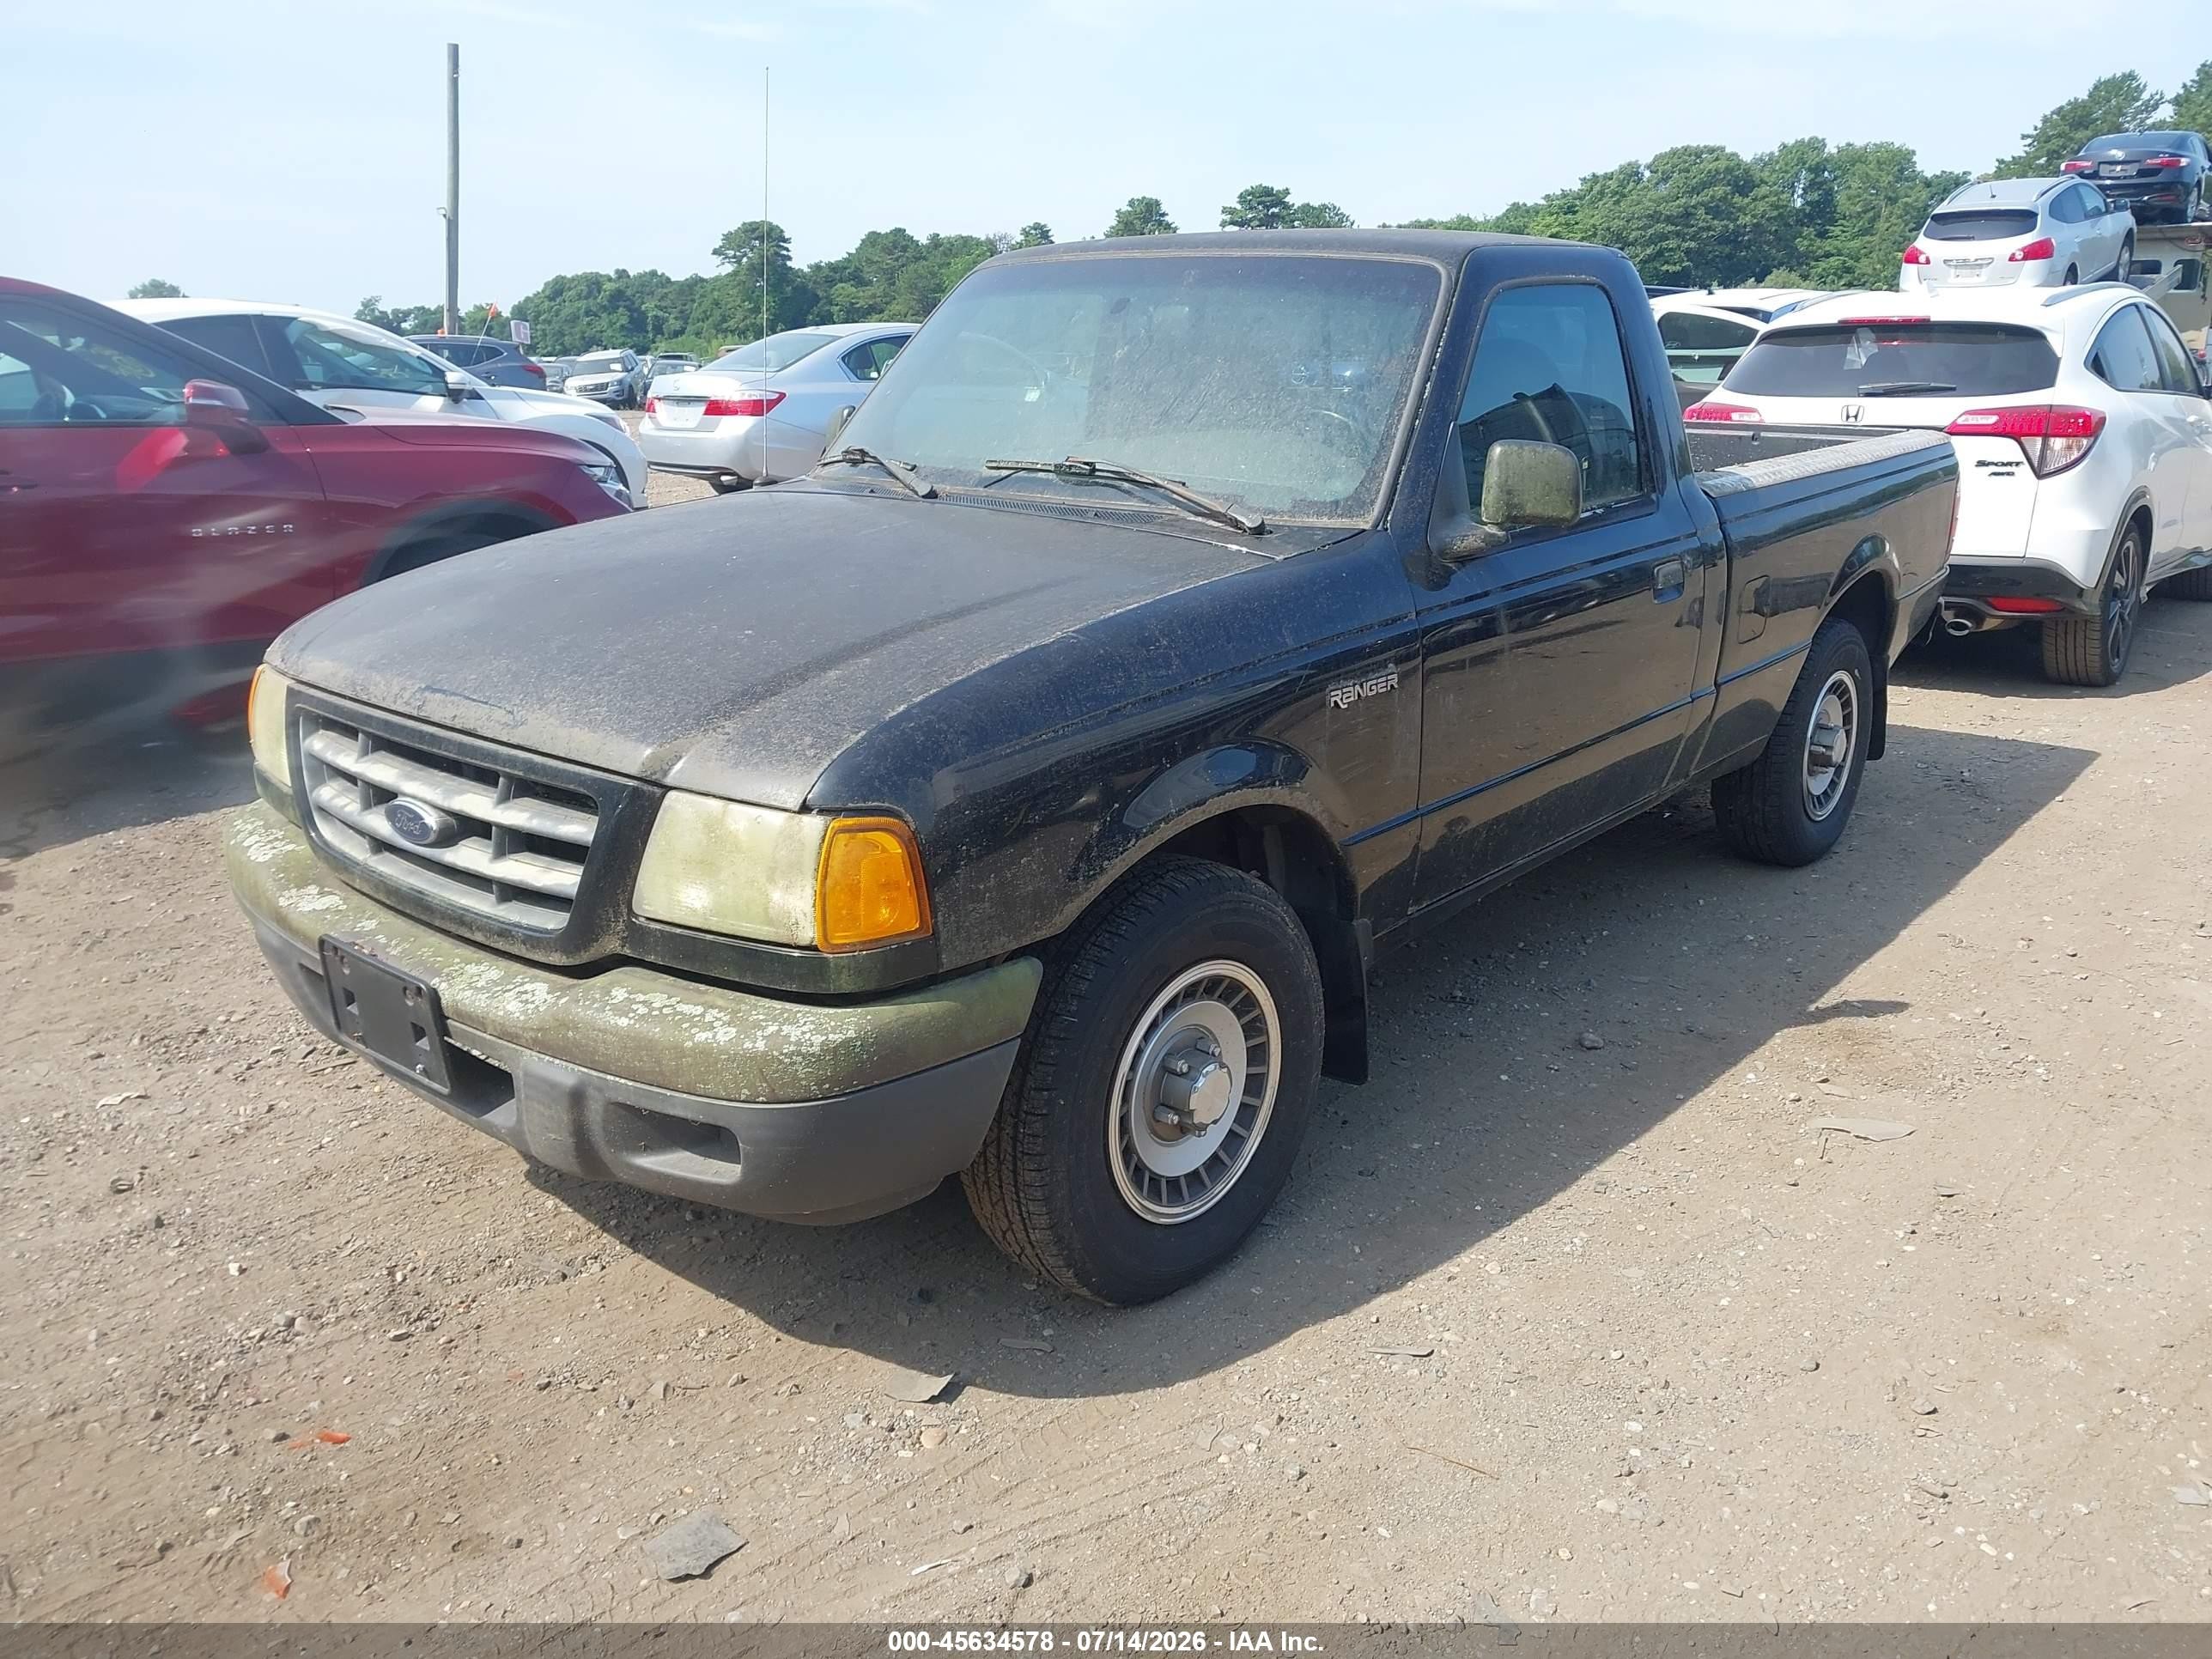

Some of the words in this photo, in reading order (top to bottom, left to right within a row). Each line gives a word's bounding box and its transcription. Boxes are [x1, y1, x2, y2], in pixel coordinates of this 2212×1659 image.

[191, 523, 295, 538] BLAZER
[1328, 673, 1400, 709] RANGER
[394, 809, 426, 836] Ford
